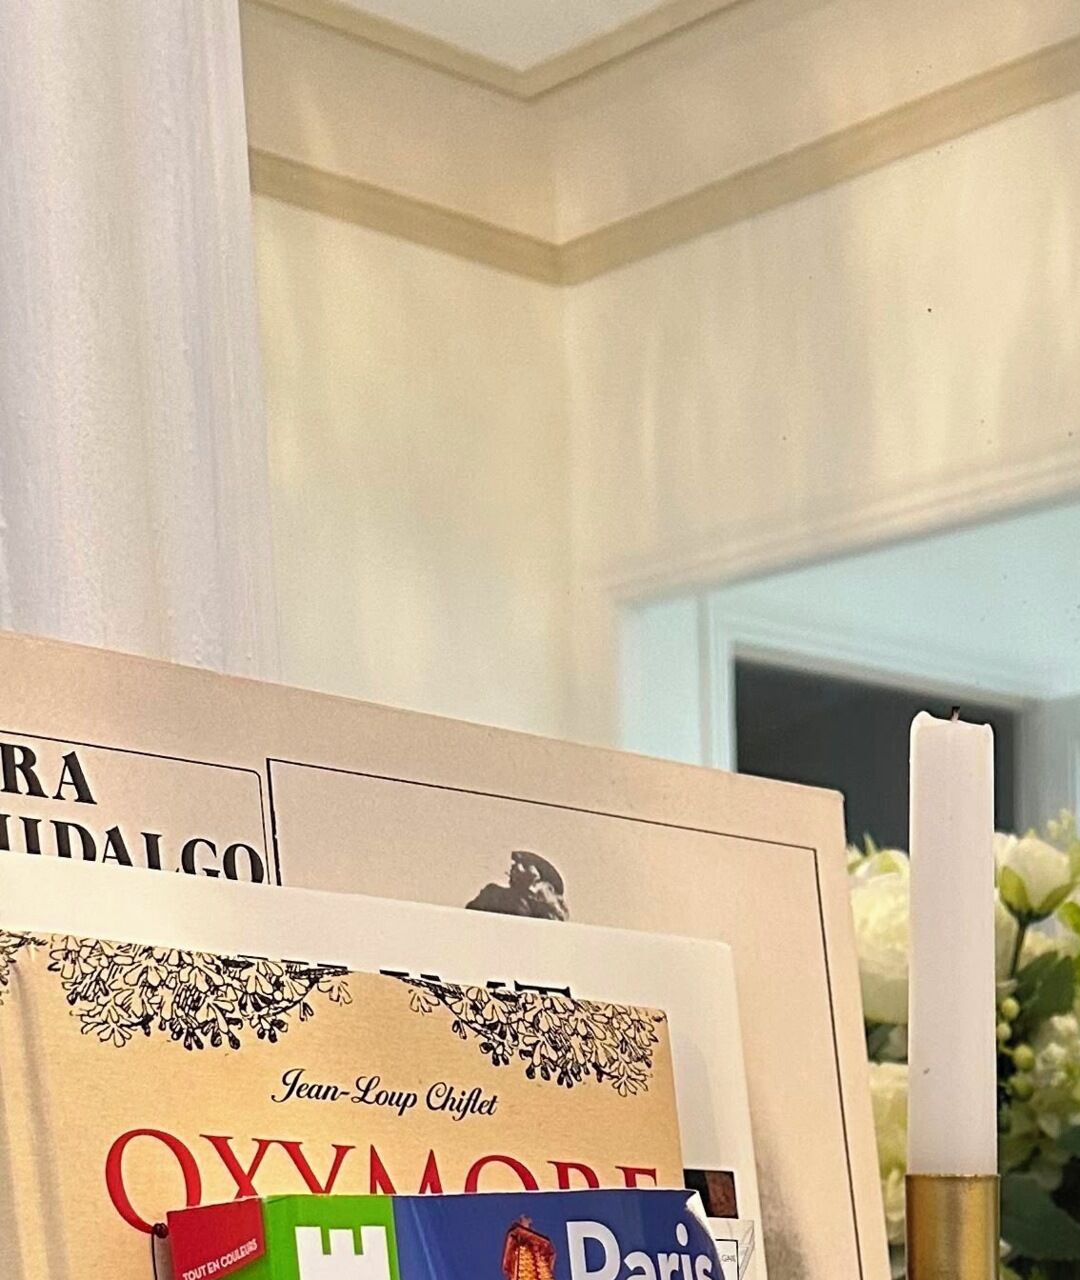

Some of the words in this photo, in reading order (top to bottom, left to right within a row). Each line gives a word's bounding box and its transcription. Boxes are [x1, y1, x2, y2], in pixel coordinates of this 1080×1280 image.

[271, 1067, 418, 1116] Jean-Loup
[425, 1081, 499, 1121] Chiflet
[208, 1259, 220, 1275] EN
[220, 1238, 259, 1270] COULEURS
